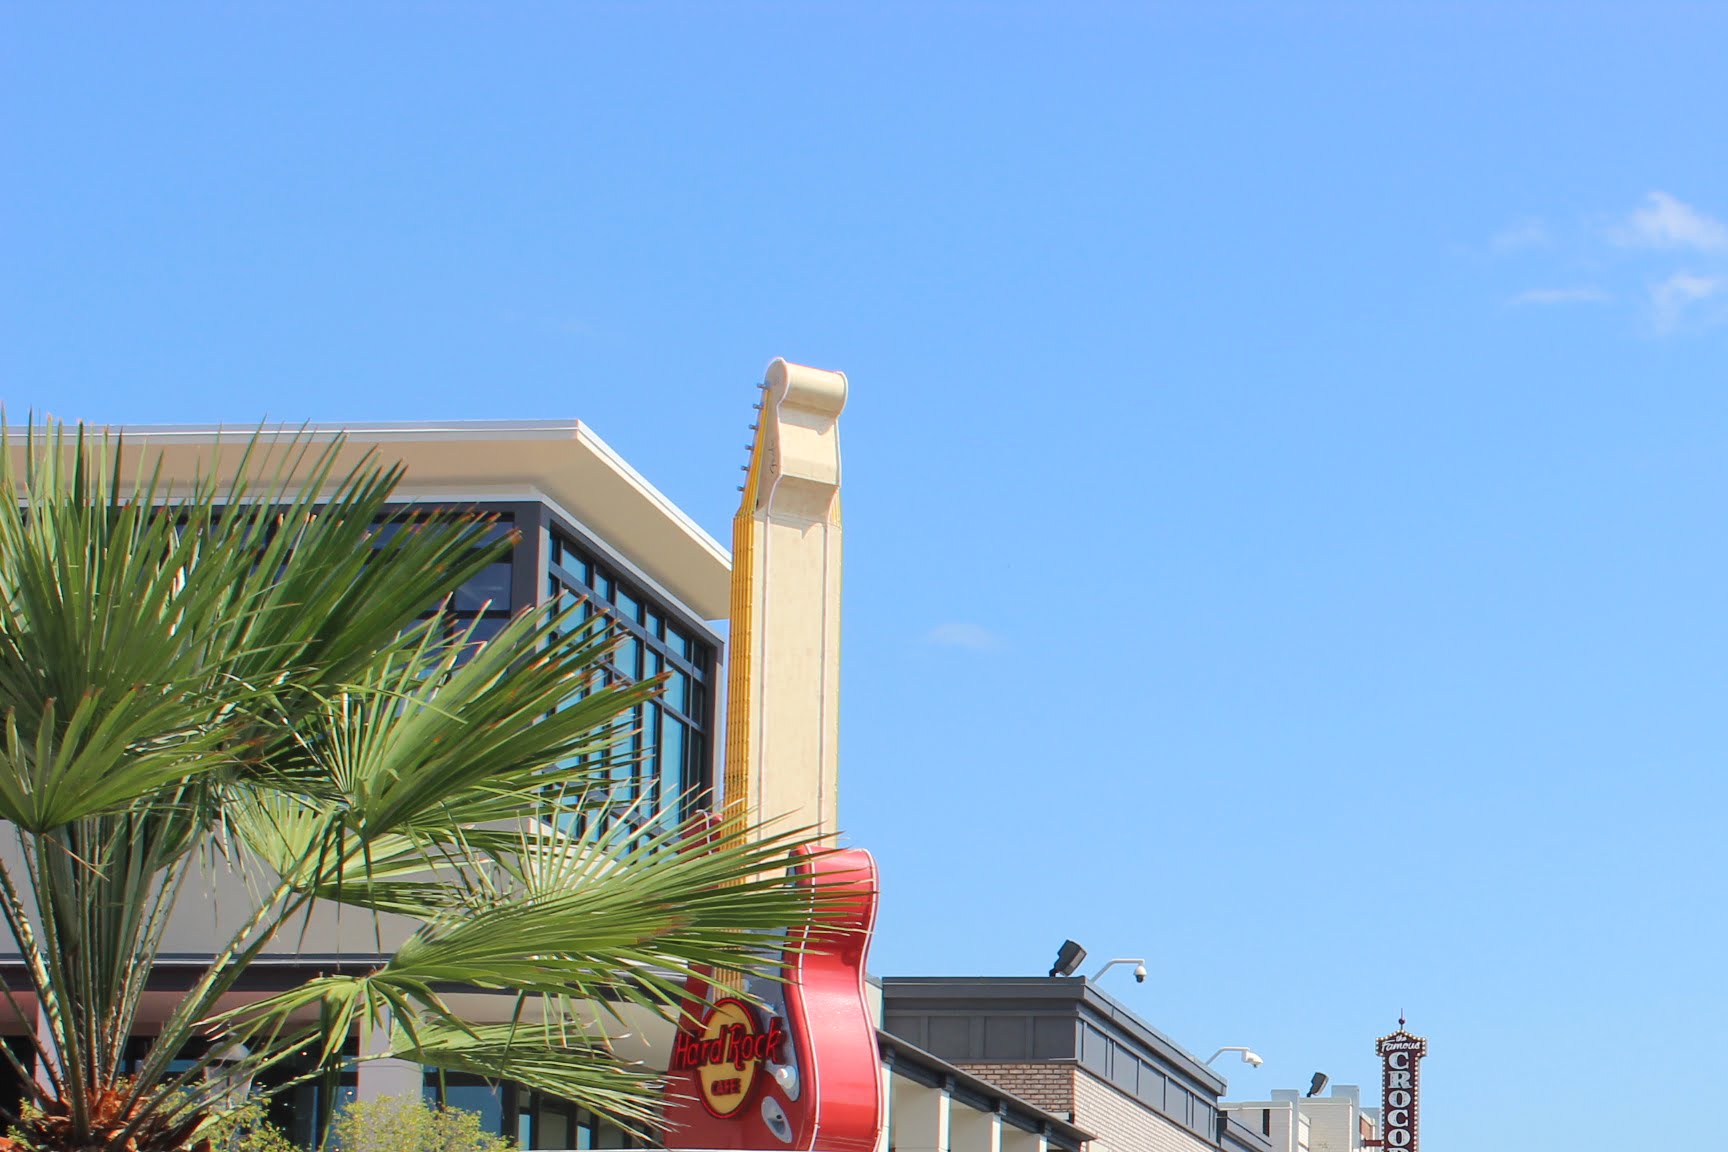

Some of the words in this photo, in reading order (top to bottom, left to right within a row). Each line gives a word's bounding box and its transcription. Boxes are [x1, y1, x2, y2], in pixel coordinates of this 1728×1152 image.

[675, 1024, 728, 1070] Hard
[727, 1016, 787, 1071] Rock
[1381, 1040, 1422, 1052] Famous
